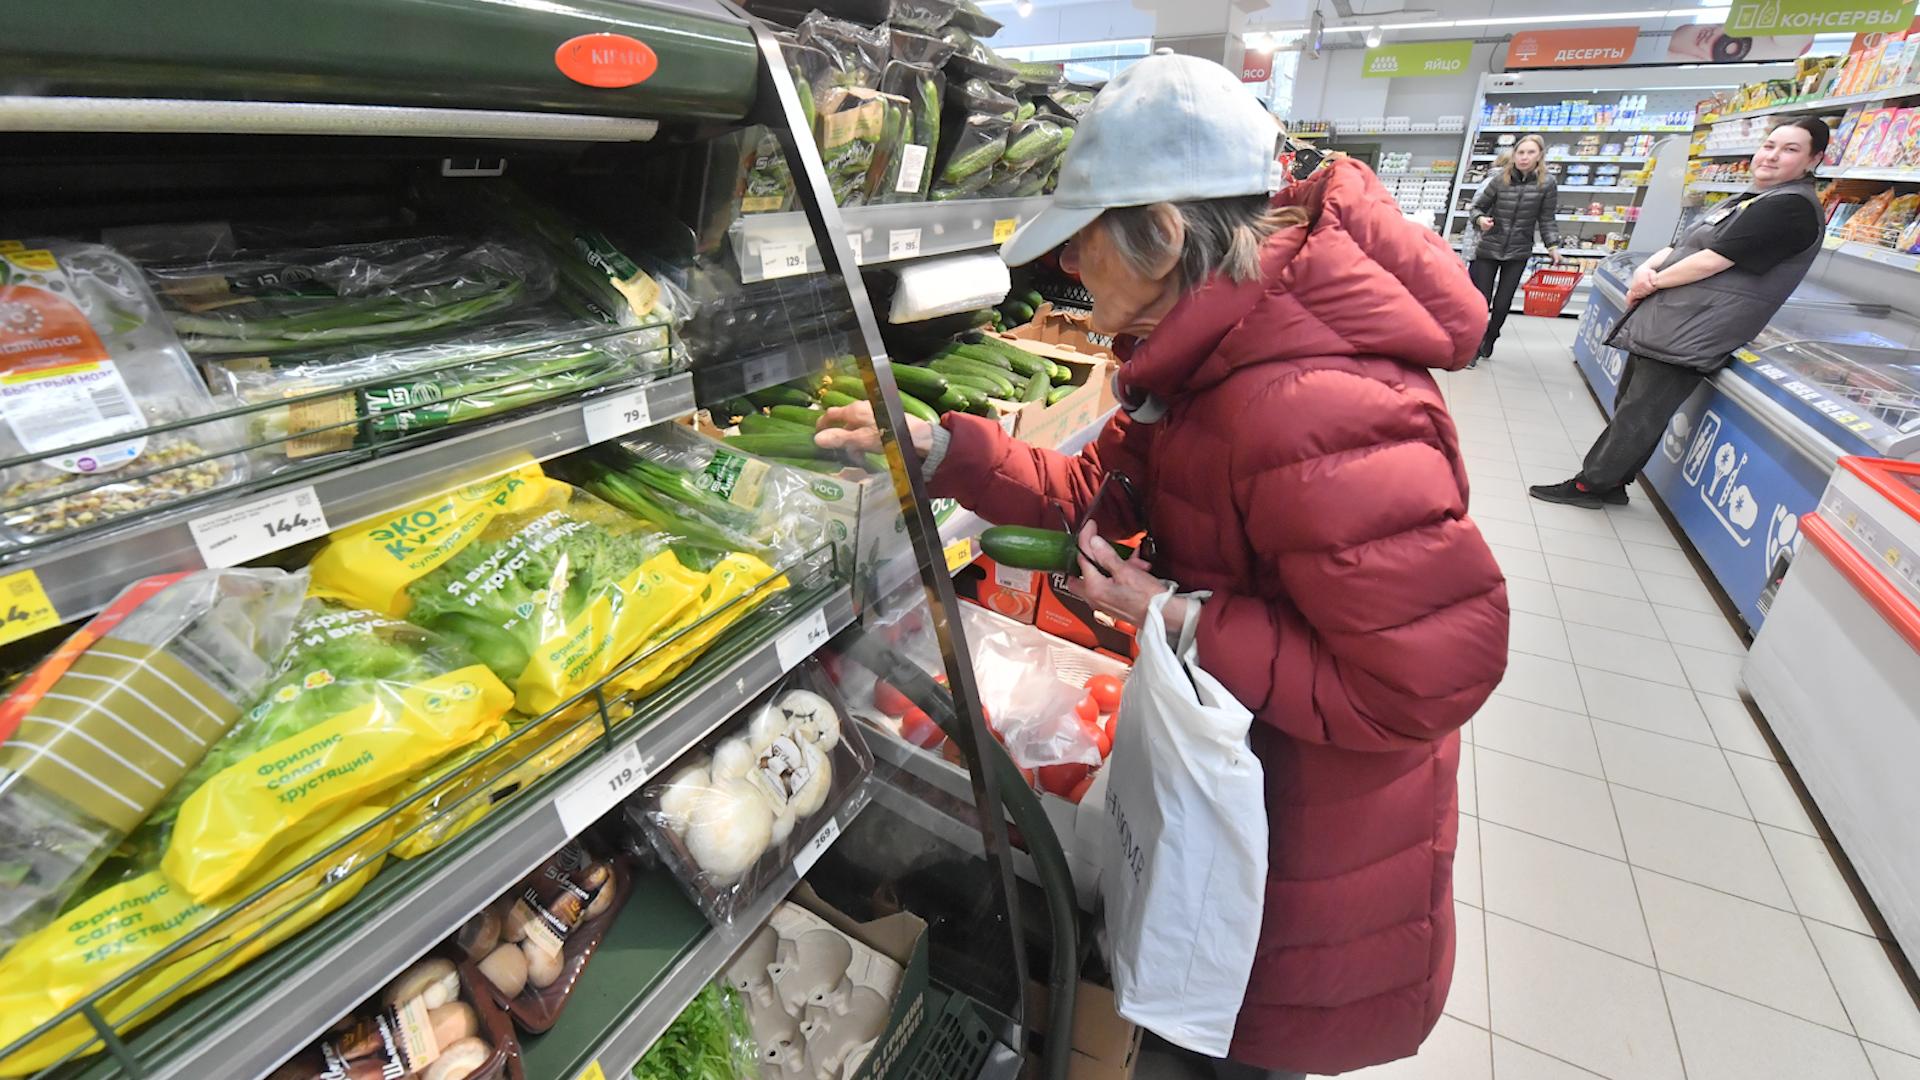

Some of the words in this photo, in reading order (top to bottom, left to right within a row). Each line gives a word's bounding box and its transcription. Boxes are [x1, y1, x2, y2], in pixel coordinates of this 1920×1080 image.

[1779, 9, 1902, 28] КОНСЕРВЫ
[1424, 59, 1462, 71] ЯЙЦО
[1554, 47, 1625, 63] ДЕСЕРТЫ
[1242, 68, 1265, 79] ЯСО
[256, 733, 344, 777] Фриллис
[266, 758, 322, 791] салат
[276, 750, 375, 804] хрустящий
[608, 768, 633, 791] 119
[67, 883, 169, 932] Фриллис
[74, 911, 144, 945] салат
